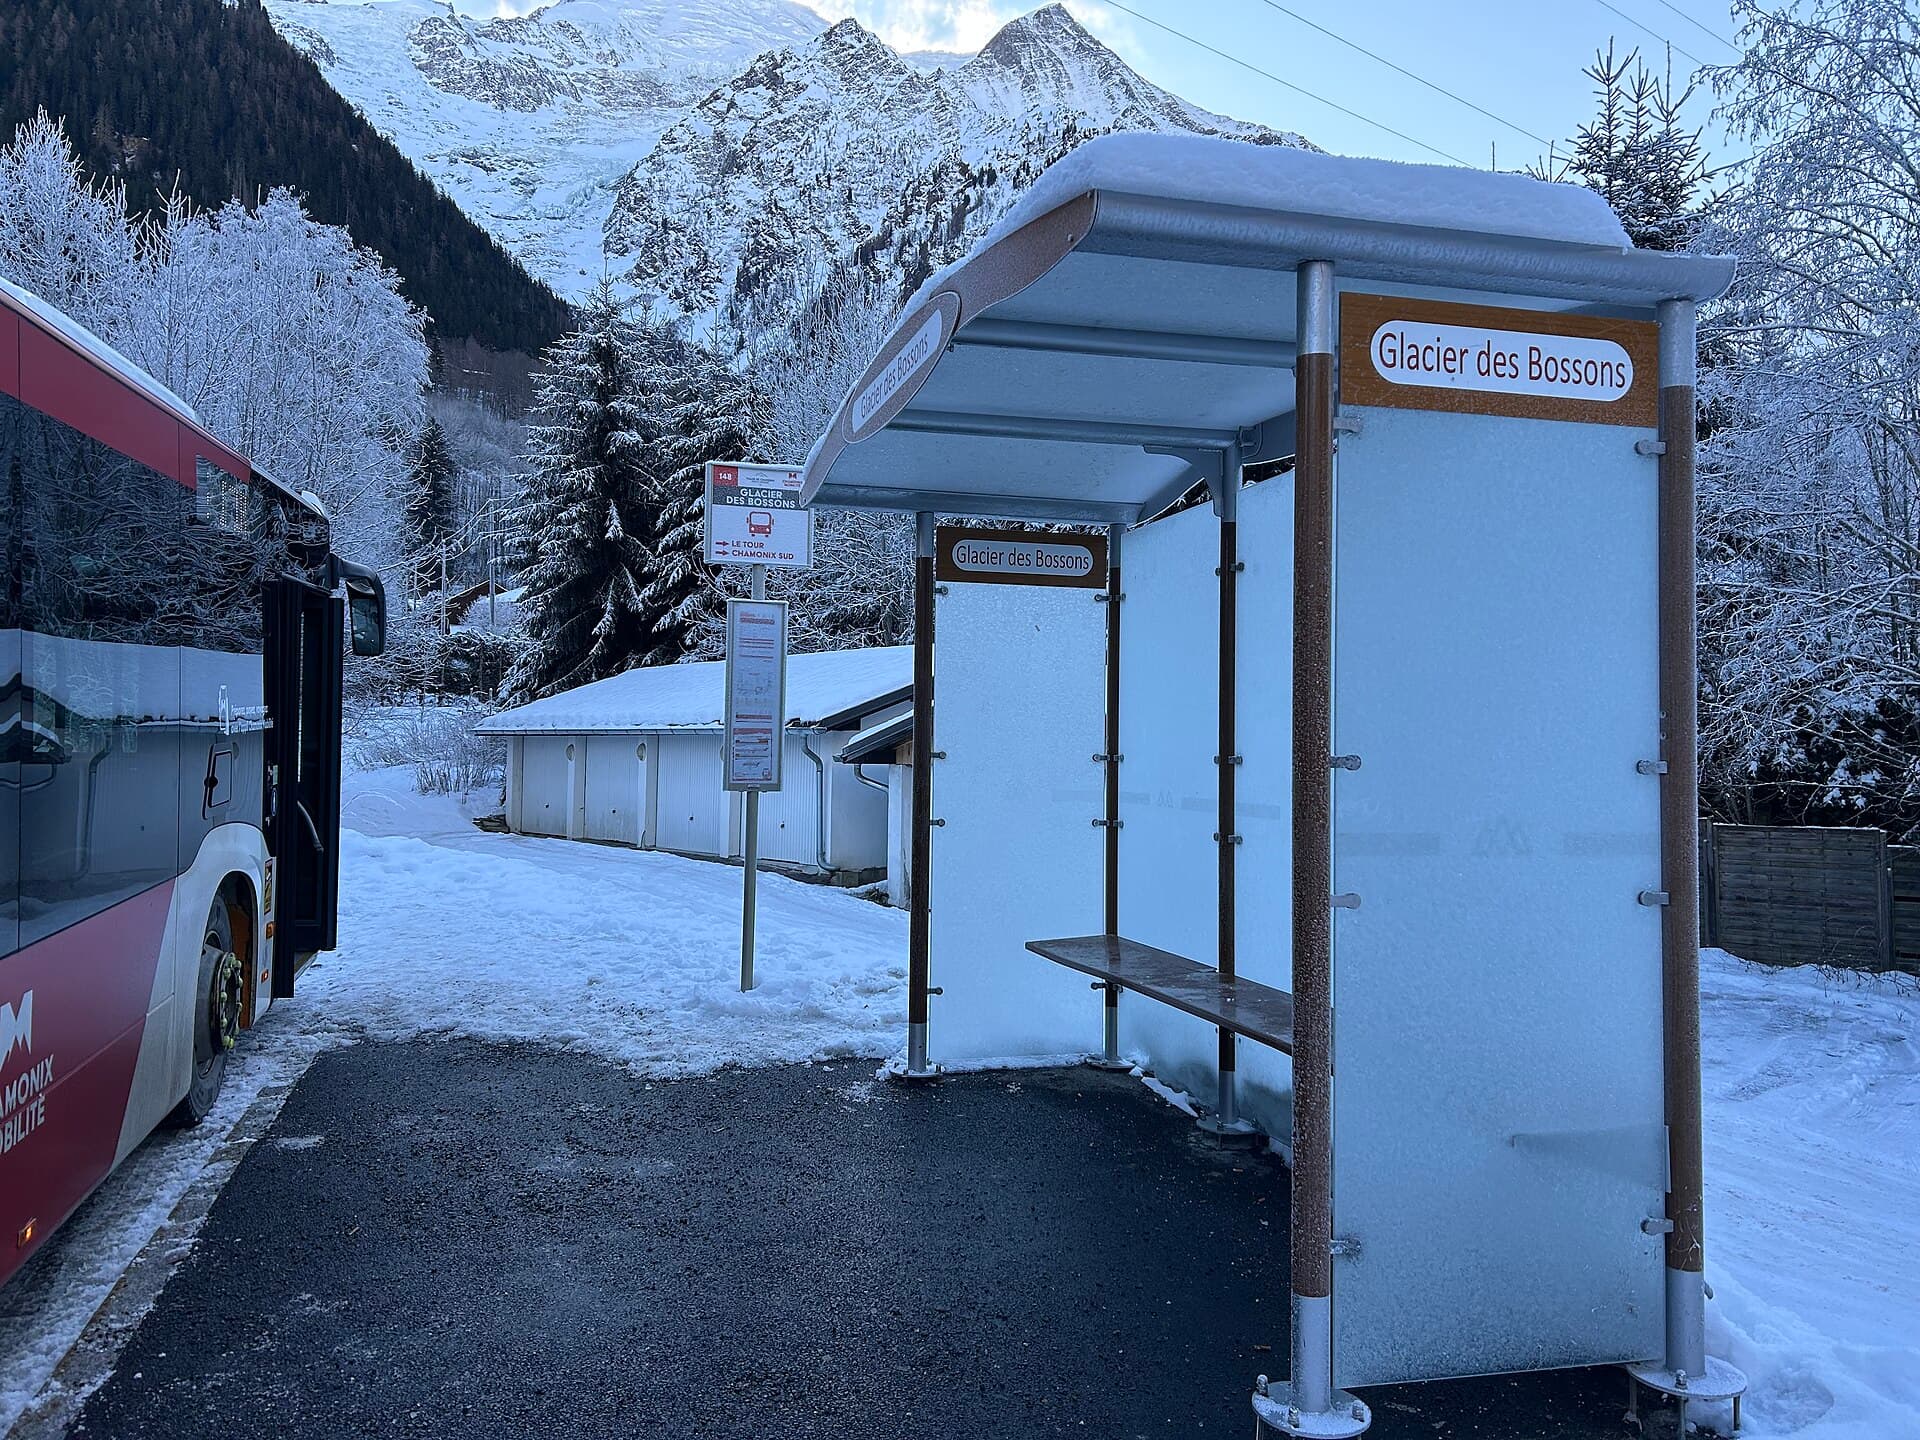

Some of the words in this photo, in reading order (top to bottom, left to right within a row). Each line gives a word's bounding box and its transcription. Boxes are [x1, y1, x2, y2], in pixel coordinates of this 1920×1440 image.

[1379, 331, 1469, 375] Glacier
[1476, 340, 1519, 379] des
[1528, 346, 1626, 388] Bossons
[861, 383, 882, 418] Glacier
[884, 368, 896, 396] des
[898, 333, 929, 380] Bossons
[740, 488, 783, 499] GLACIER
[726, 496, 745, 505] DES
[747, 499, 796, 509] BOSSONS
[731, 540, 741, 548] LE
[743, 541, 765, 549] TOUR
[731, 549, 777, 559] CHAMONIX
[778, 552, 794, 560] SUD
[956, 545, 1005, 566] Glacier
[1008, 547, 1032, 567] des
[1036, 549, 1089, 570] Bossons
